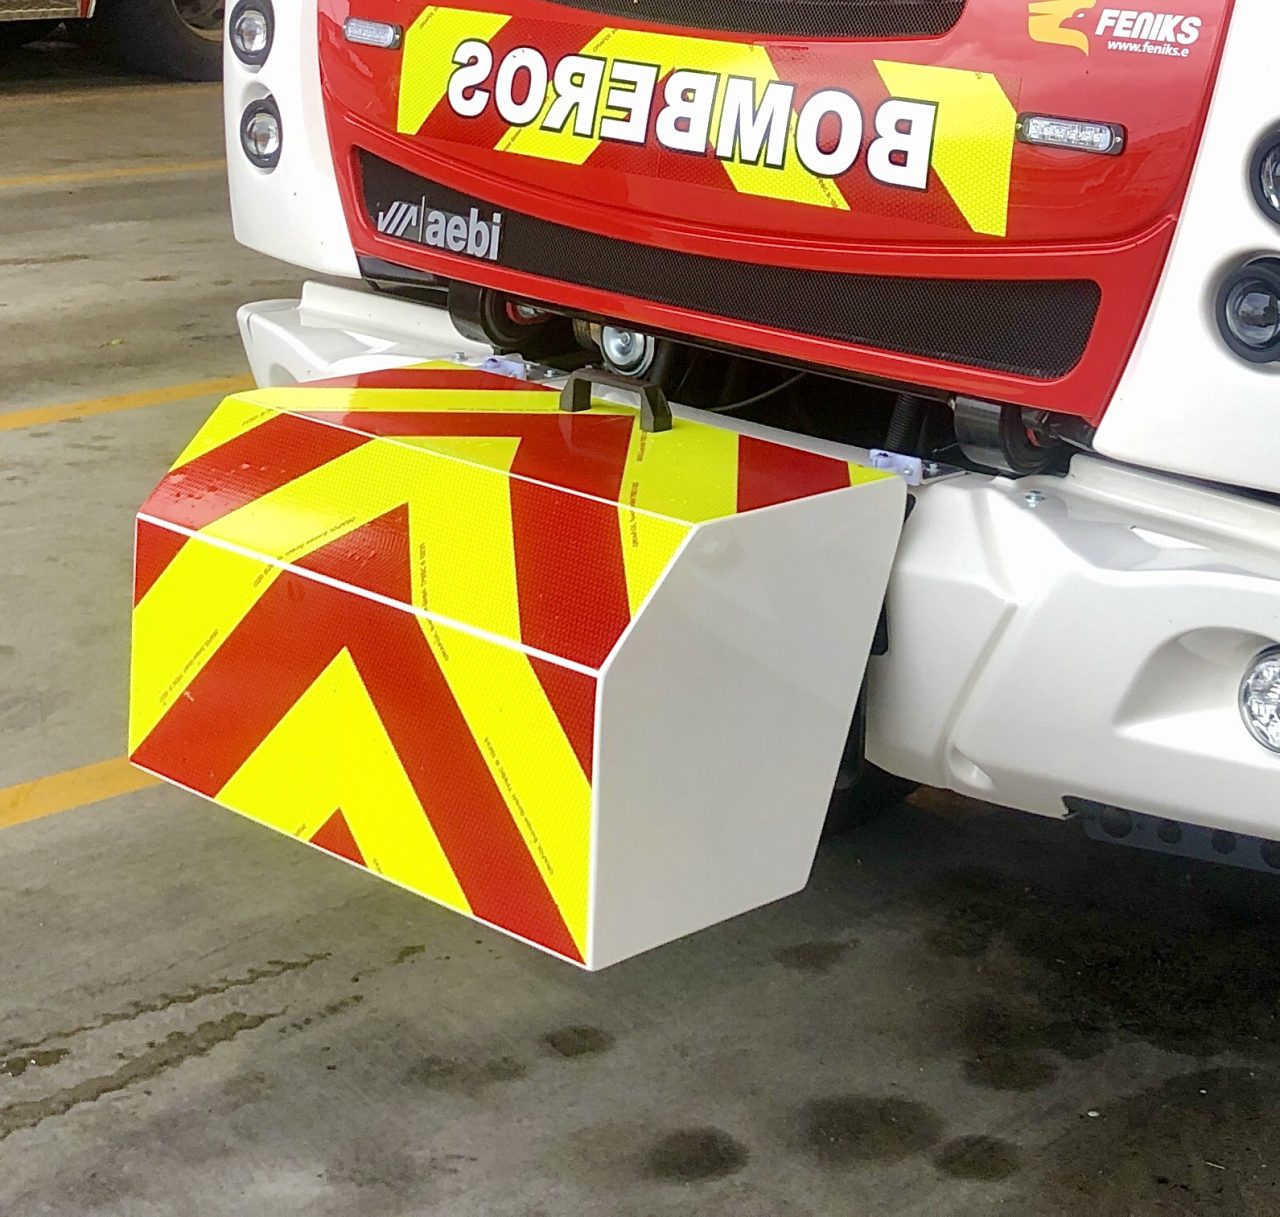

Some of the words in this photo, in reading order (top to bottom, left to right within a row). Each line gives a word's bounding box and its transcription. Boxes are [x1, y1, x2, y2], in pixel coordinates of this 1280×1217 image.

[1095, 8, 1202, 45] FENIKS
[1107, 40, 1190, 57] www.feniks.e
[425, 207, 502, 261] aebi
